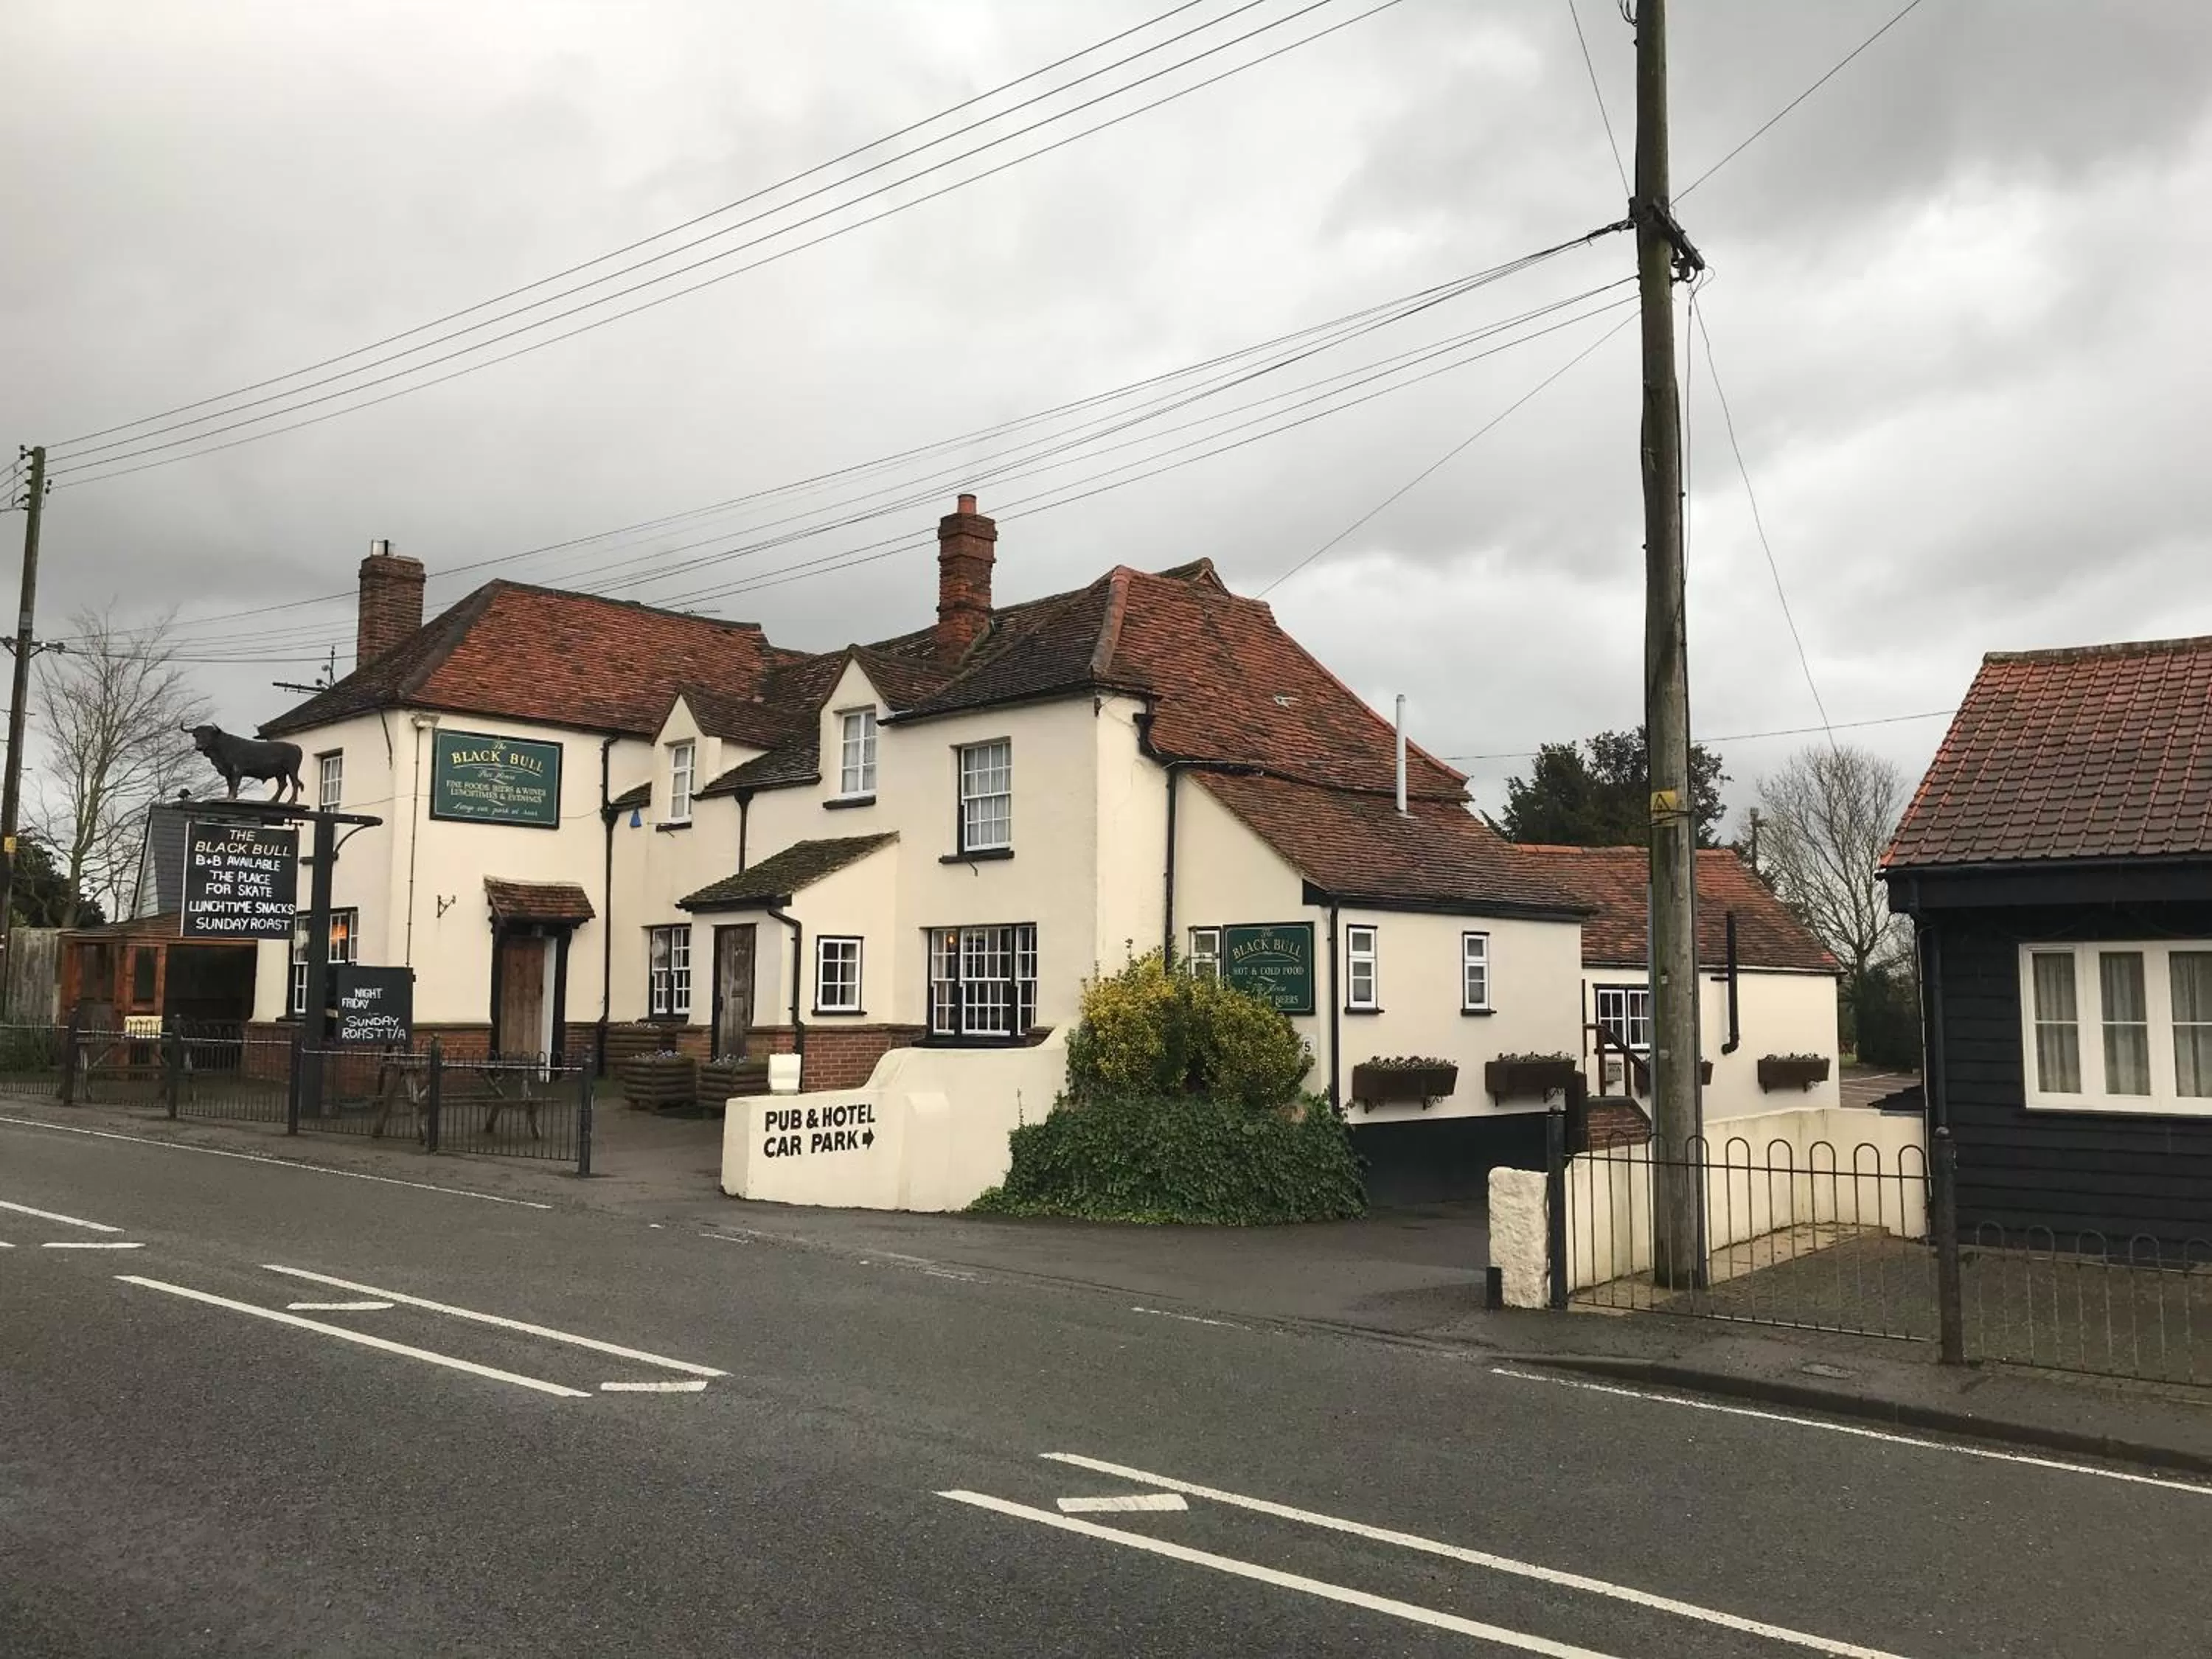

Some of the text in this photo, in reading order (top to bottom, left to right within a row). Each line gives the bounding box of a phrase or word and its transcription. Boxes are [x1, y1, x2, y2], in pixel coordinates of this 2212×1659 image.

[451, 750, 543, 772] BLACK BULL
[229, 830, 255, 841] THE
[195, 841, 291, 856] BLACK BULL
[195, 855, 281, 872] B+B AVAILABLE
[209, 870, 234, 883] THE
[206, 883, 273, 897] FOR SKATE
[188, 900, 295, 915] LUNCHTIME SNACKS
[195, 917, 291, 931] SUNDAY ROAST
[1232, 939, 1301, 959] BLACK BULL
[1260, 967, 1281, 975] COLD
[1283, 967, 1304, 975] FOOD
[355, 988, 383, 998] NIGHT
[346, 1015, 399, 1027] SUNDAY
[341, 1027, 383, 1040] ROAST
[765, 1104, 875, 1132] PUB & HOTEL
[763, 1130, 859, 1158] CAR PARK
